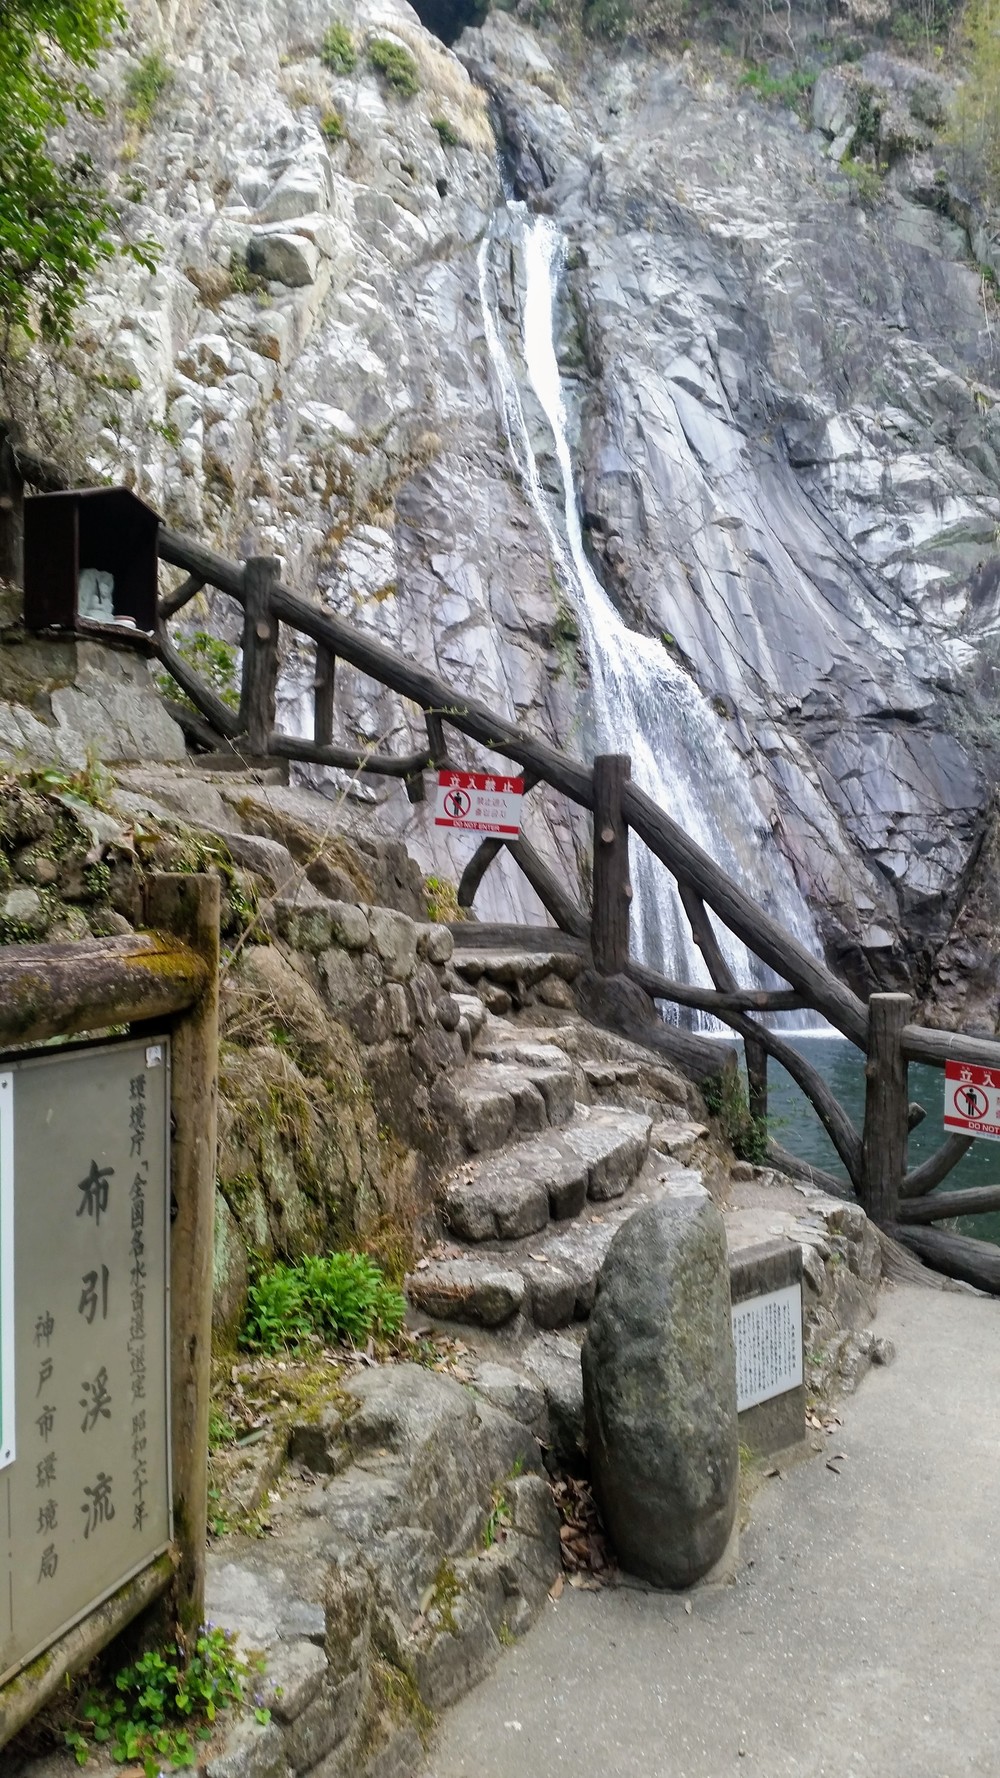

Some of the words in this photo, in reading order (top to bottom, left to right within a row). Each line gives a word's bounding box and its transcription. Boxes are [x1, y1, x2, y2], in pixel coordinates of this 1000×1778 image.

[449, 775, 514, 794] 立入禁止
[464, 821, 478, 830] NOT
[968, 1121, 981, 1129] DO
[982, 1124, 1000, 1134] NOT
[32, 1310, 59, 1585] 神戸市環境局
